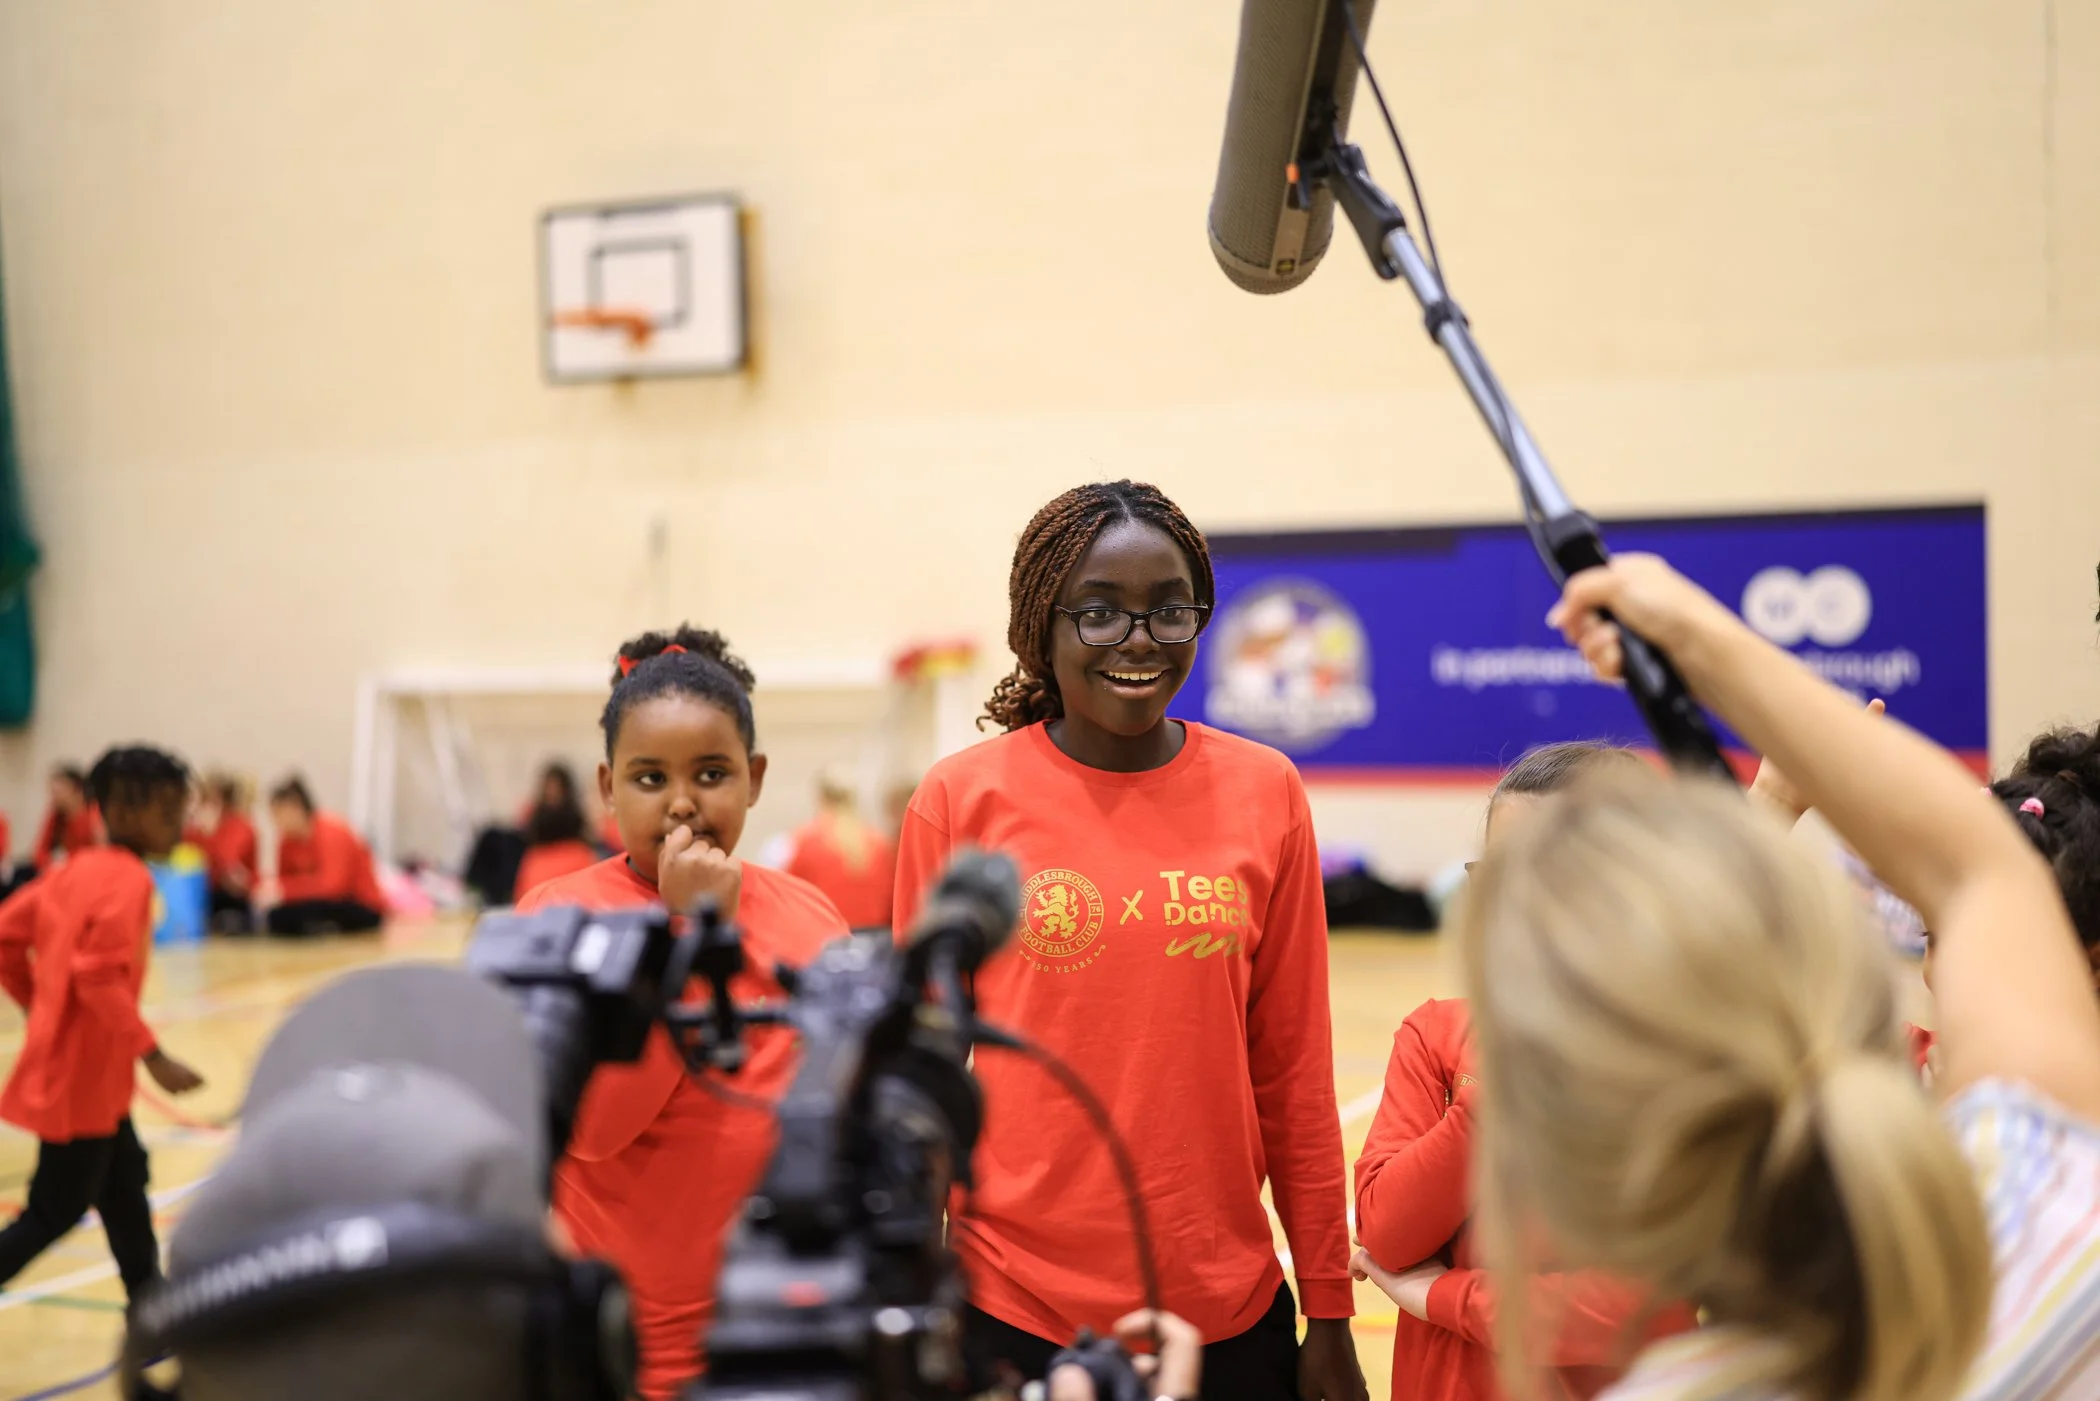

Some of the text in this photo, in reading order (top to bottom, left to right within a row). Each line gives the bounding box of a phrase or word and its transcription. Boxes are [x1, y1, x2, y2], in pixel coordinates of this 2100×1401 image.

[1022, 871, 1098, 905] IDDLESBROUGH
[1159, 870, 1248, 906] Tees
[1020, 920, 1099, 955] FOOTBALL CLUB
[1055, 956, 1093, 974] YEARS
